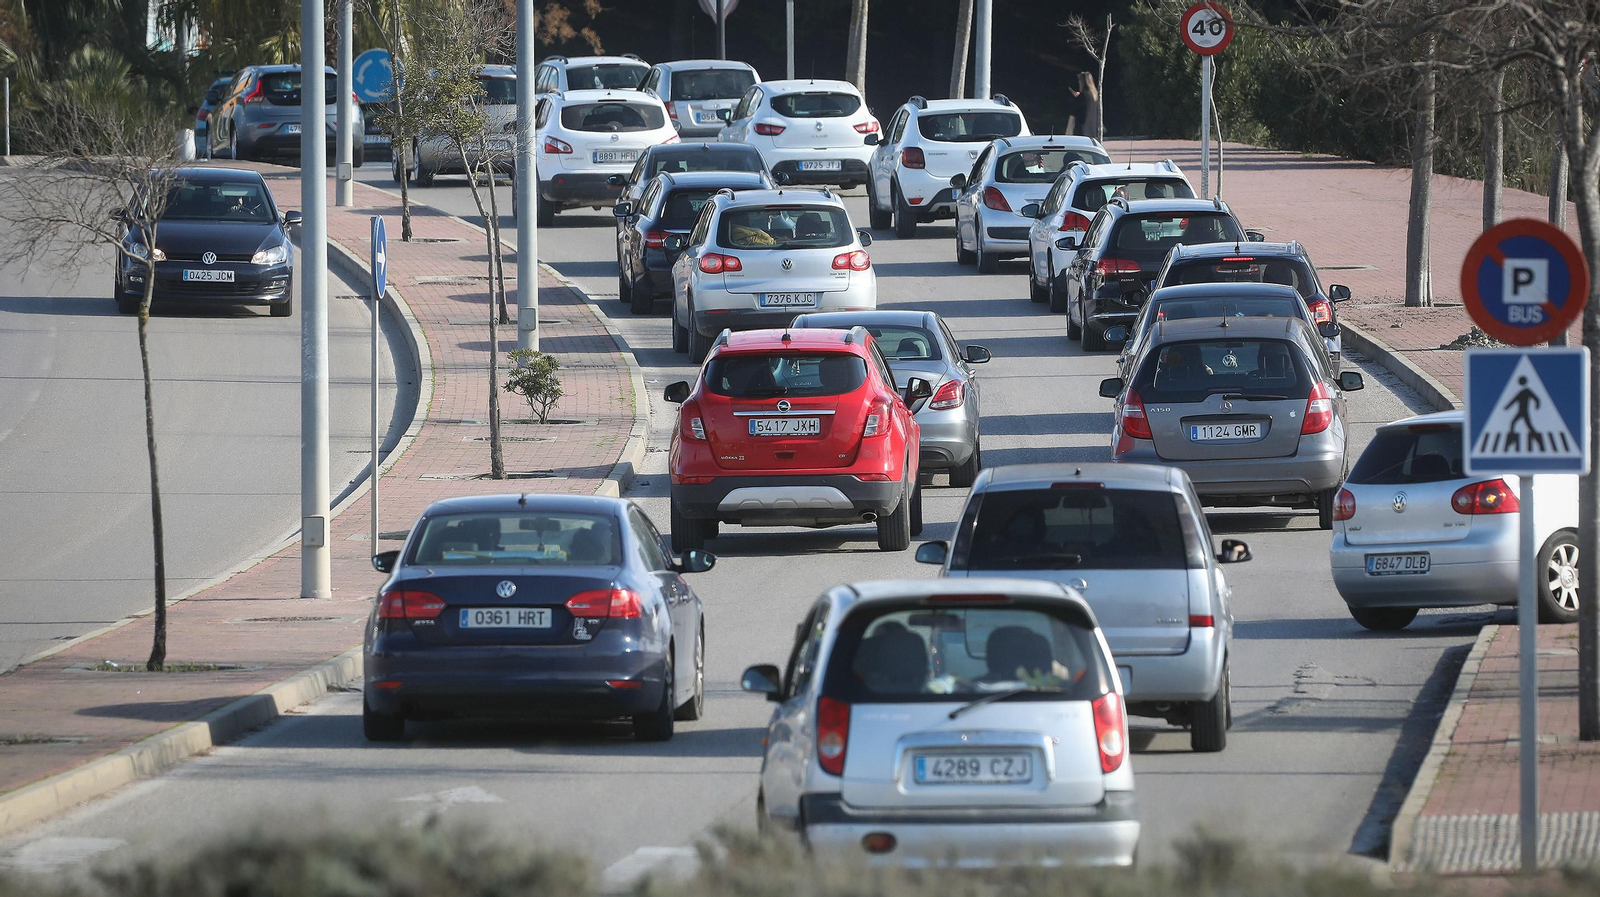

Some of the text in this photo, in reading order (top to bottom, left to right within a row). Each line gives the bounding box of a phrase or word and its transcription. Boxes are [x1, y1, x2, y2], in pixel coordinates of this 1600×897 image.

[1191, 20, 1222, 36] 40
[599, 152, 617, 161] 8891
[803, 161, 840, 169] 9725 JTJ
[189, 270, 233, 281] 0425 JCM
[1512, 267, 1535, 296] P
[767, 293, 813, 304] 7376 KJC
[1508, 304, 1544, 323] BUS
[756, 419, 817, 432] 5417 JXH
[1202, 424, 1257, 439] 1124 GMR
[1374, 555, 1427, 571] 6847 DLB
[475, 611, 545, 625] 0361 HRT
[932, 758, 1028, 779] 4289 CZJ
